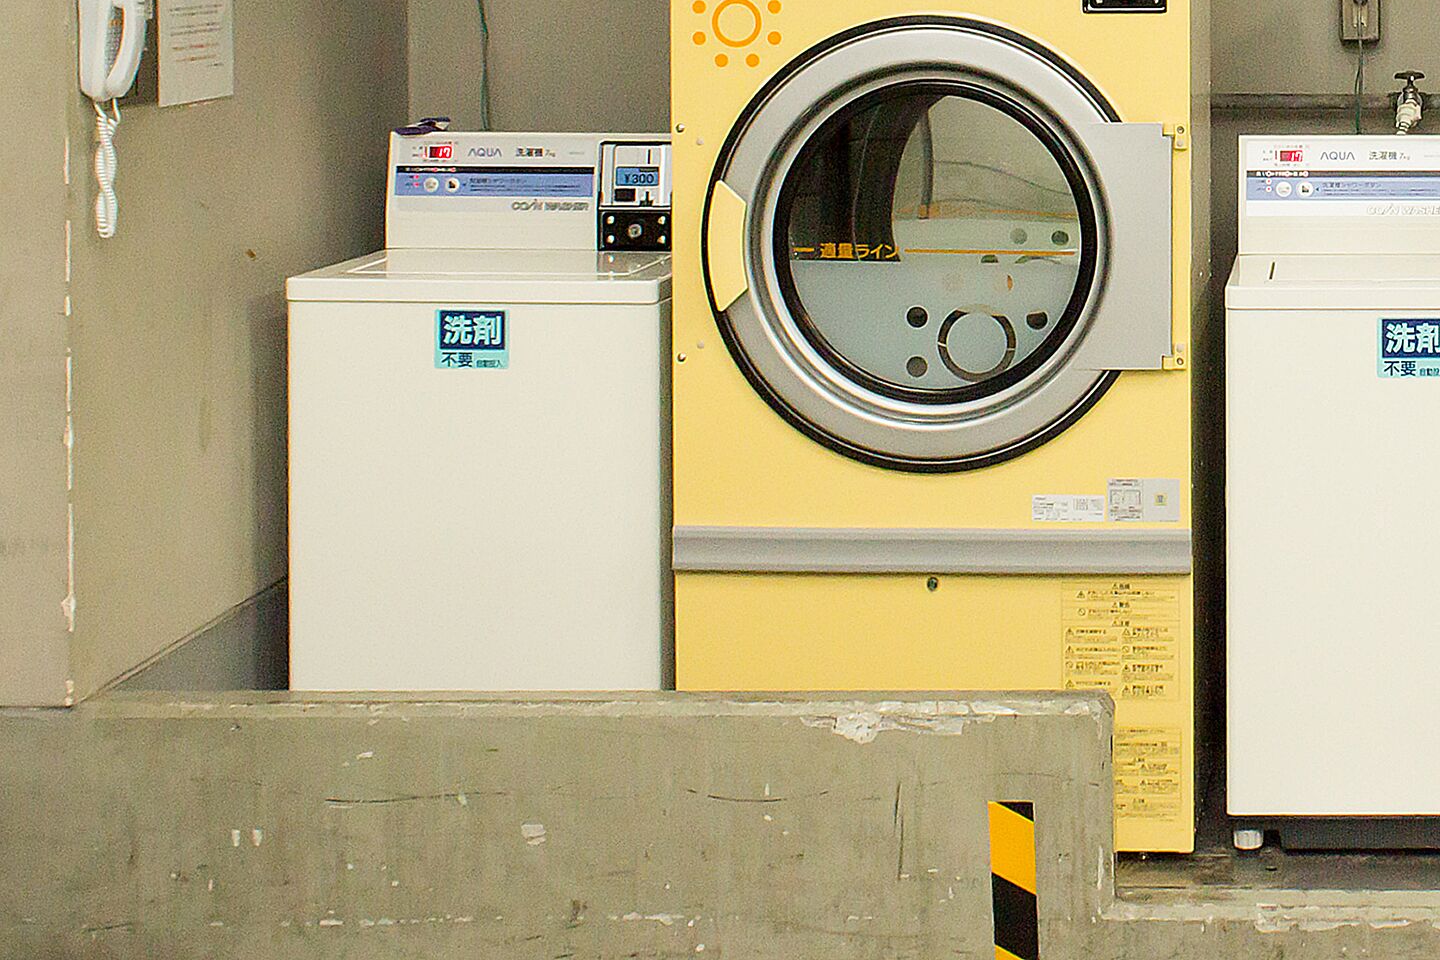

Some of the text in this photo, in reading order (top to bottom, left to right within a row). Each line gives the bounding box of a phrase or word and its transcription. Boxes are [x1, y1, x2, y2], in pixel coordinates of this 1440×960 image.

[467, 148, 503, 157] AQUA
[1320, 151, 1355, 161] AQUA
[820, 243, 900, 259] 適量ライン
[443, 315, 502, 346] 洗剤
[441, 352, 473, 368] 不要
[1383, 360, 1417, 377] 不要
